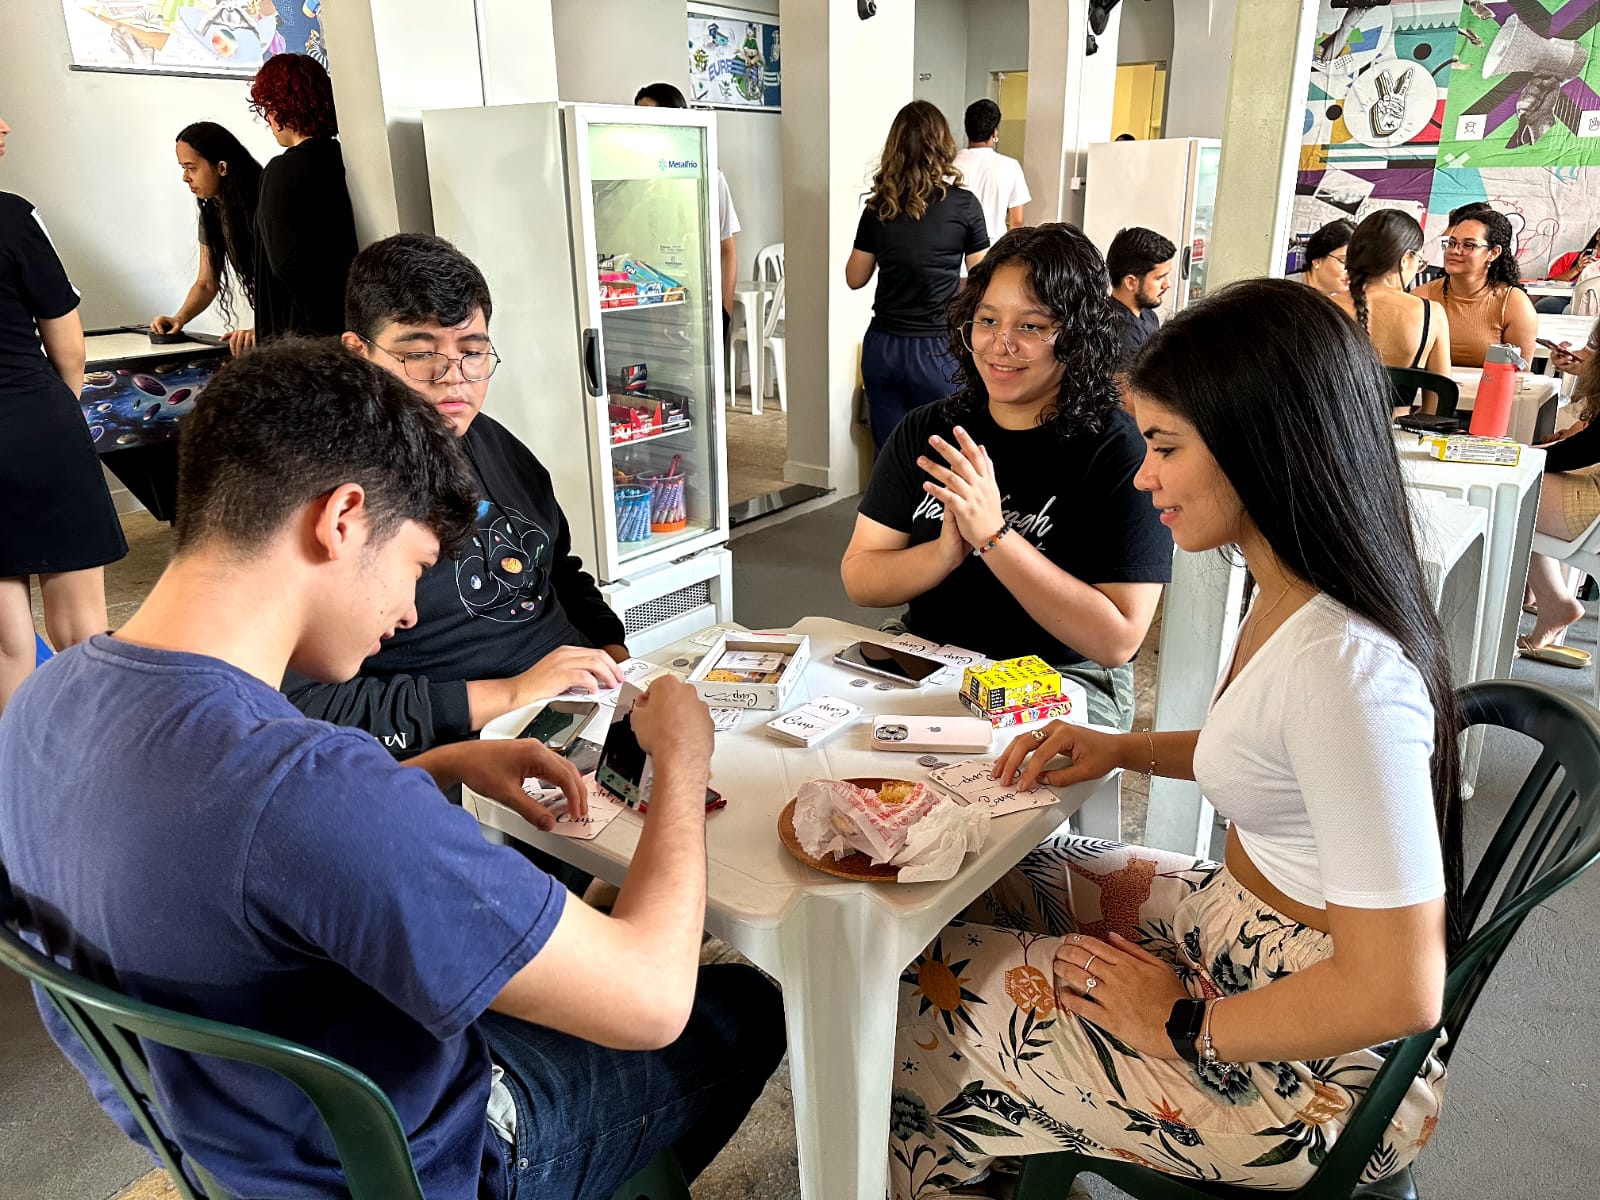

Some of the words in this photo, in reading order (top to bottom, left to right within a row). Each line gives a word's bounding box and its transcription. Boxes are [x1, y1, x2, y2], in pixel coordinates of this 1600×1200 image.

[668, 160, 698, 169] Metalfrio
[912, 492, 945, 522] Va
[1000, 494, 1057, 538] ogh
[732, 690, 758, 707] Coup
[819, 703, 850, 718] Coup
[783, 716, 814, 730] Coup
[978, 793, 1016, 808] Coup
